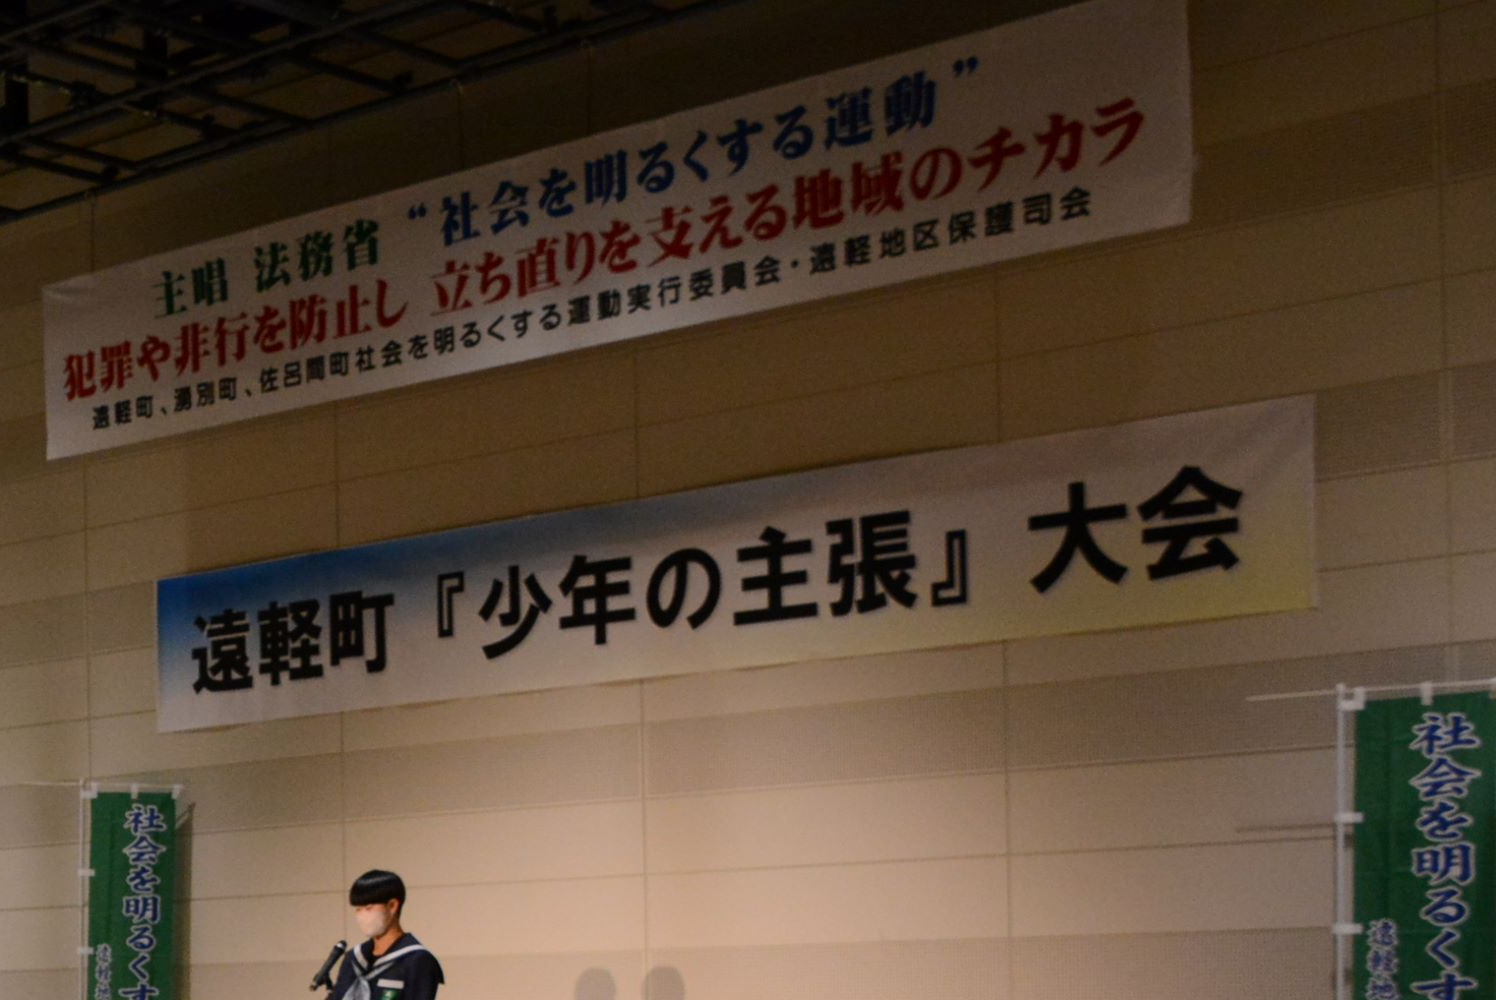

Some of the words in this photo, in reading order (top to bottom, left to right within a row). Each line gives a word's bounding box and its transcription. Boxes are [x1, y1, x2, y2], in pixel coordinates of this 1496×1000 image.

[63, 279, 408, 401] 犯罪や非行を防止し
[431, 97, 1145, 318] 立ち直りを支える地域のチカラ
[151, 257, 230, 319] 主唱
[253, 219, 381, 294] 法務省
